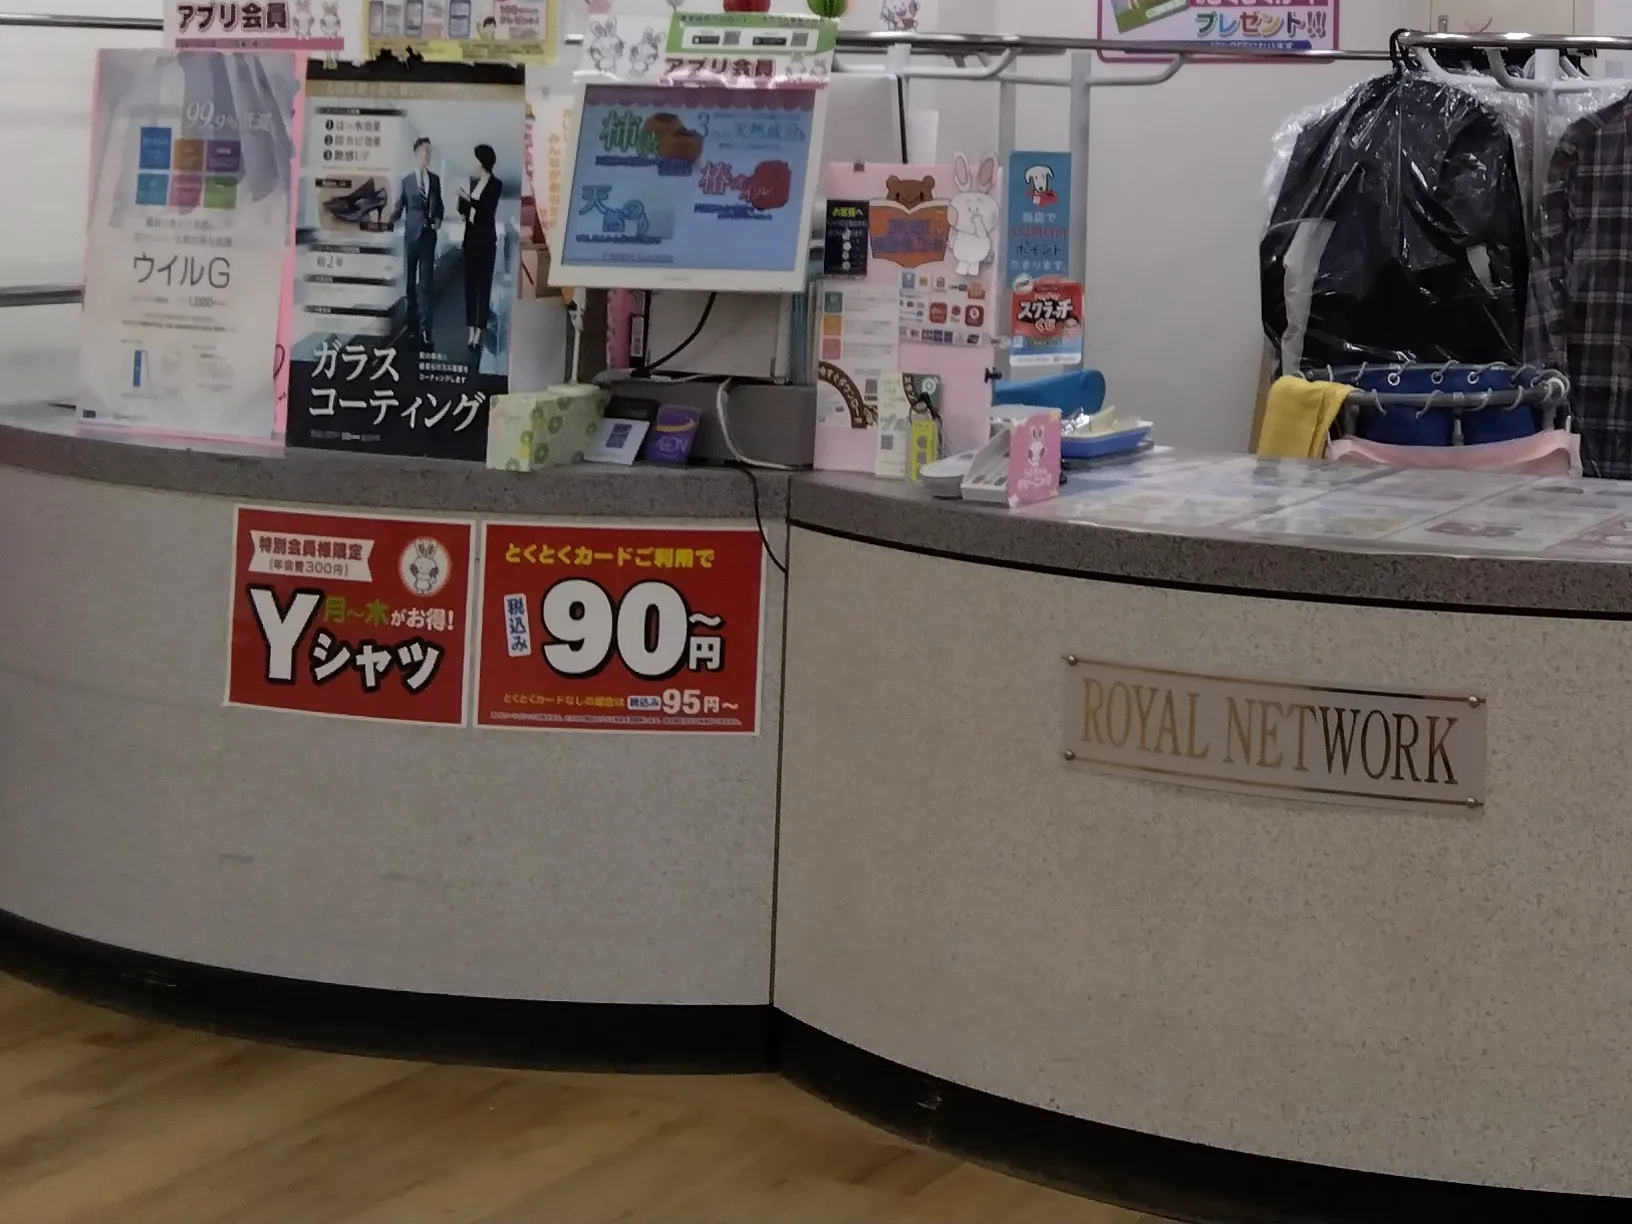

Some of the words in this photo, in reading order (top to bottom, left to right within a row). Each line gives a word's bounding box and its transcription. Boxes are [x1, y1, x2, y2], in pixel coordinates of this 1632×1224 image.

[178, 1, 289, 32] アプリ会員
[311, 340, 400, 382] ガラス
[309, 388, 486, 432] コーティング
[259, 536, 363, 562] 特別会員様限定
[505, 543, 716, 570] とくとくカードご利用で
[248, 585, 441, 691] Yシャツ
[507, 598, 528, 653] 税込み
[541, 577, 690, 678] 90
[1081, 677, 1210, 760] ROYAL
[1223, 696, 1459, 786] NETWORK
